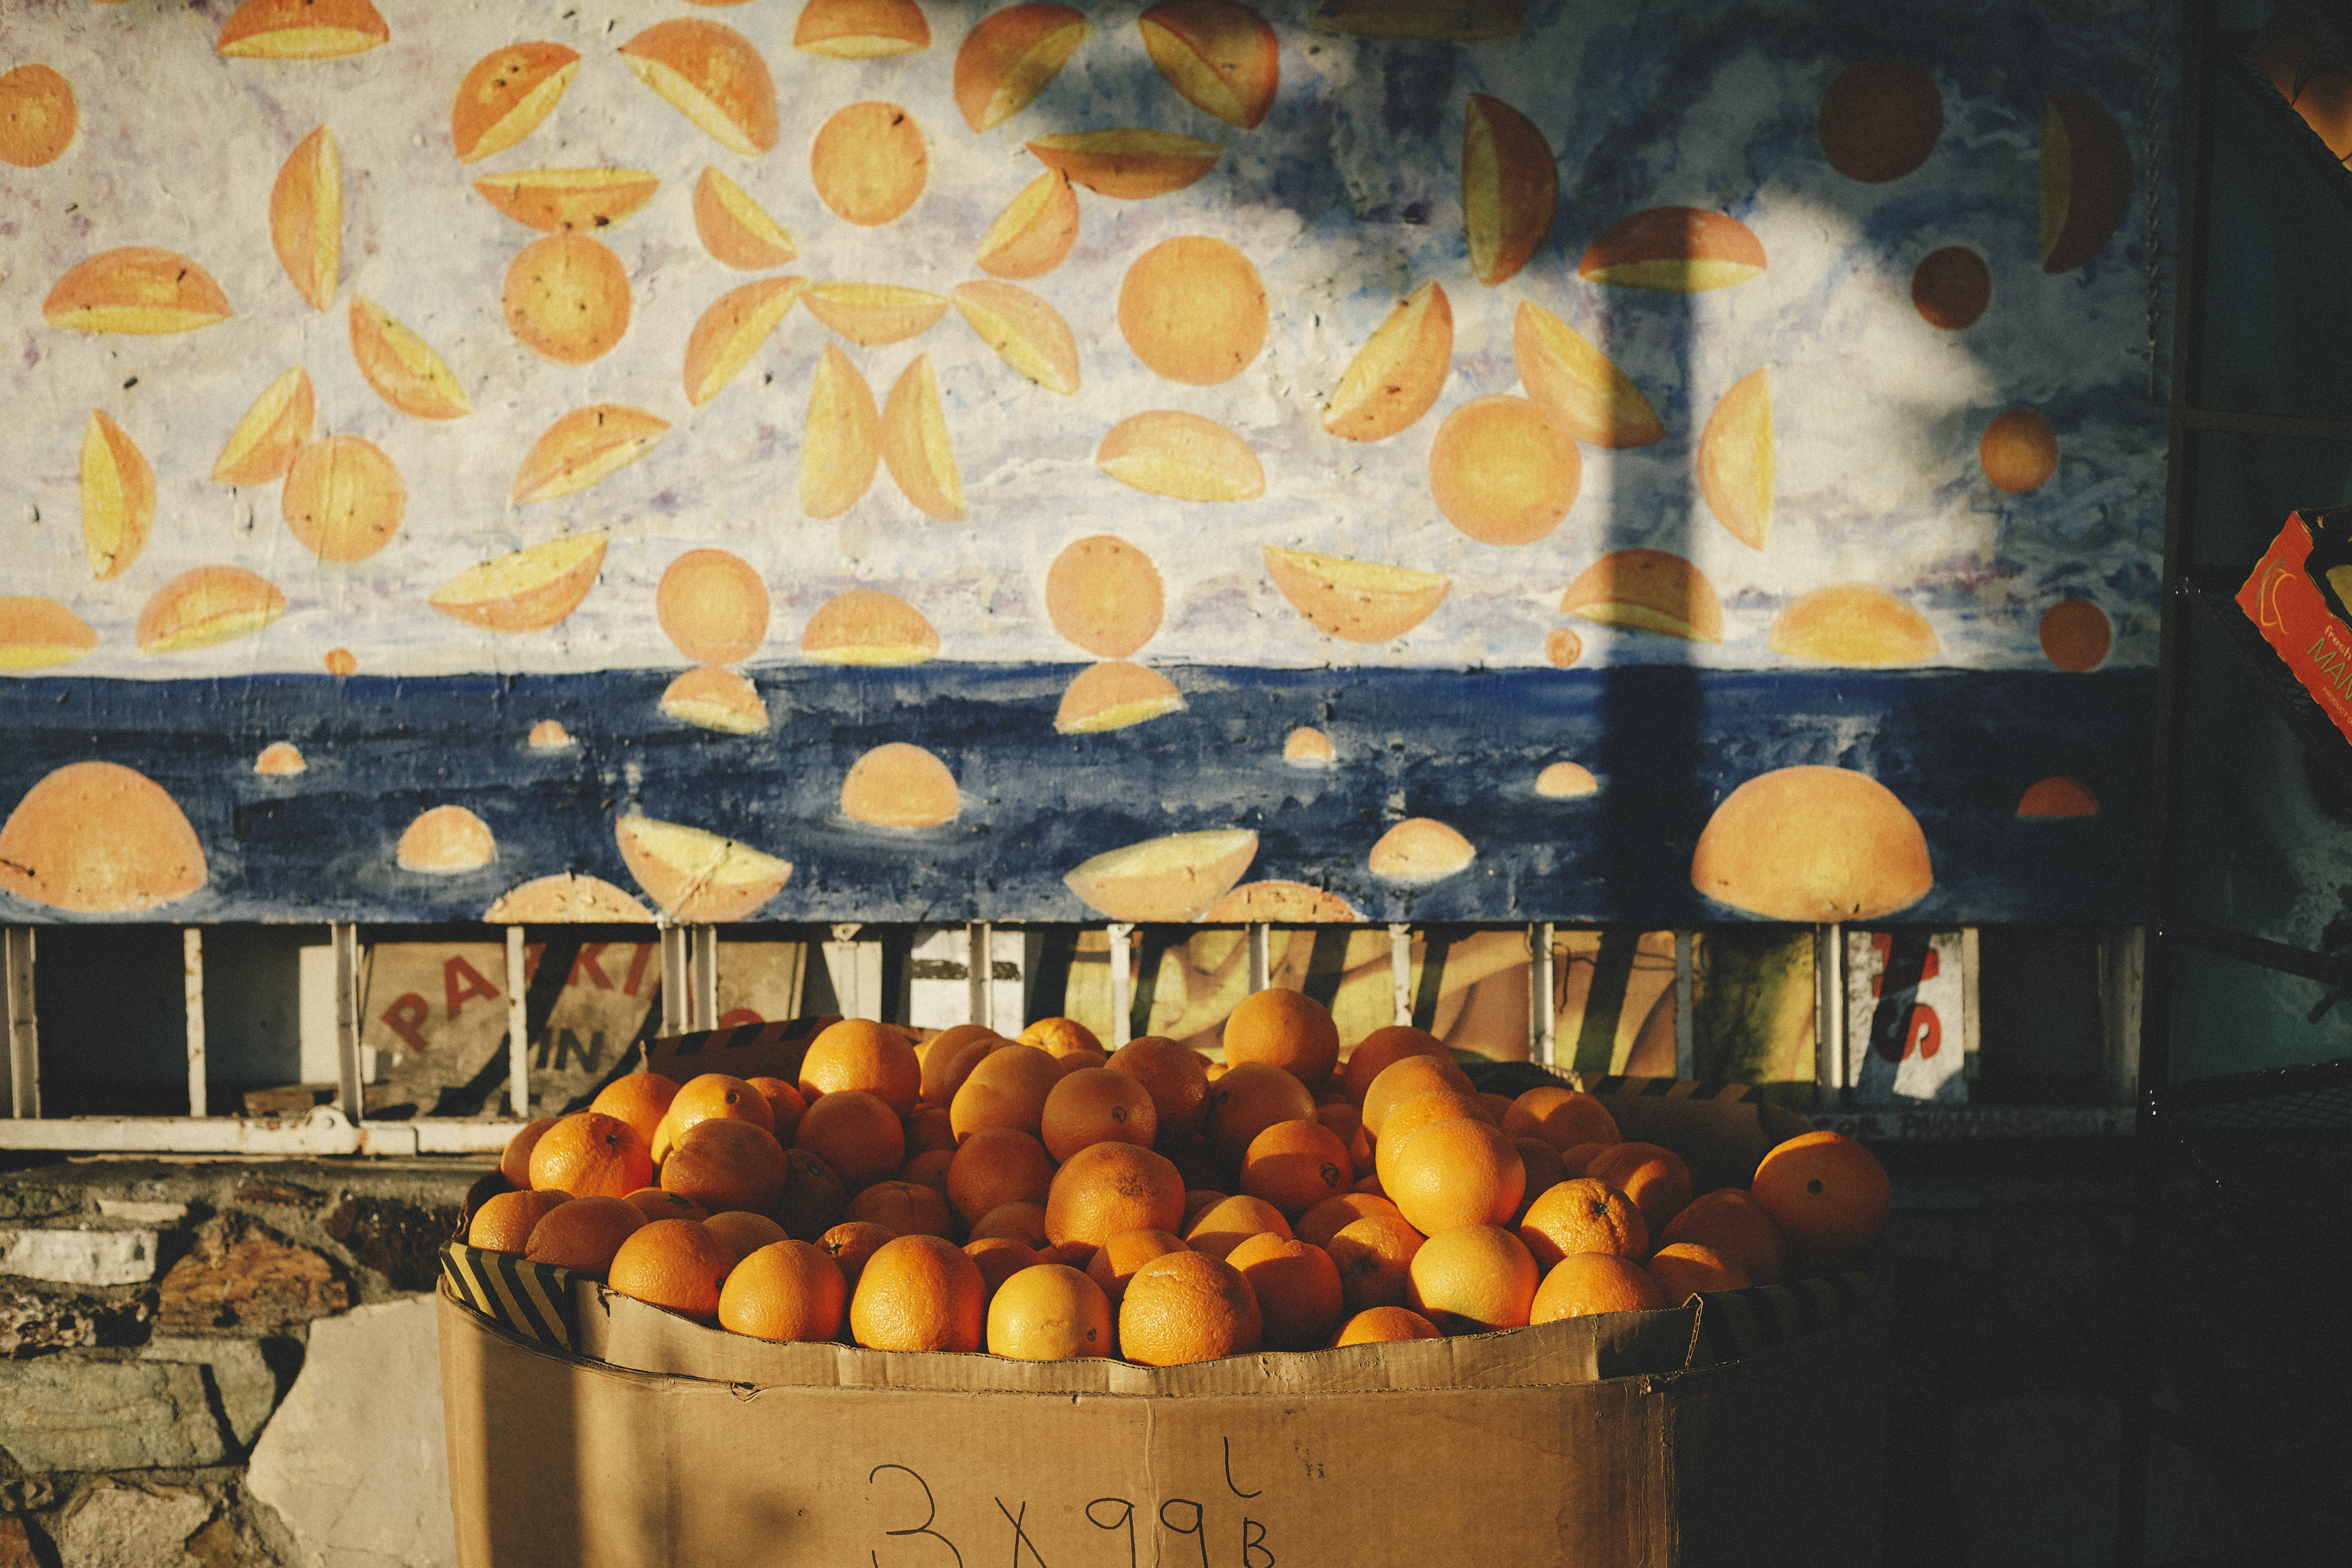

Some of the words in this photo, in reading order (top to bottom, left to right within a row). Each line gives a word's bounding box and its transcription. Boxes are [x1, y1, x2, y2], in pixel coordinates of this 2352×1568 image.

[2324, 625, 2351, 660] fresh
[2322, 686, 2348, 717] PRODUCT
[870, 1464, 963, 1568] 3
[1086, 1497, 1209, 1568] 99
